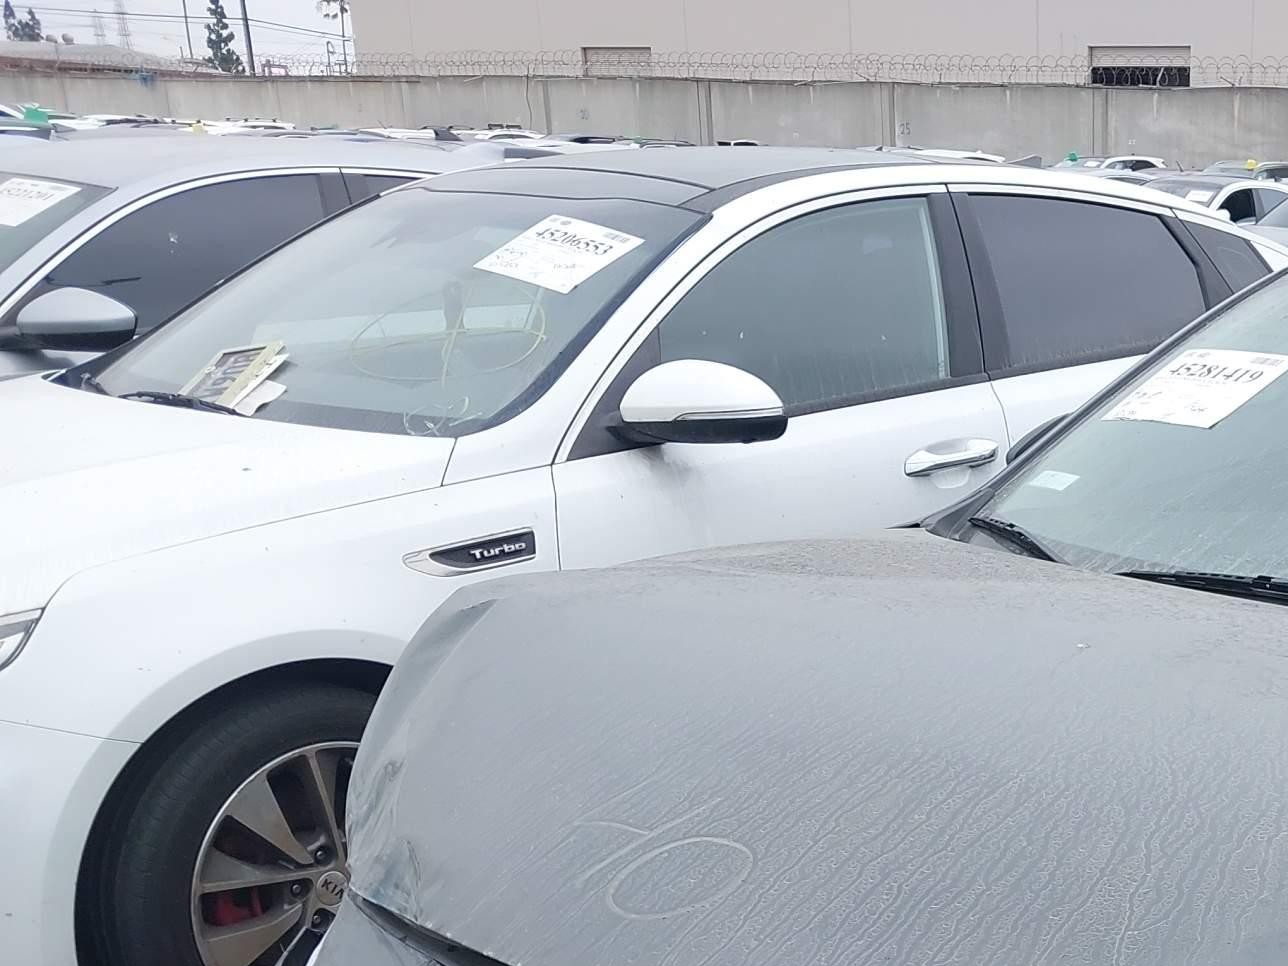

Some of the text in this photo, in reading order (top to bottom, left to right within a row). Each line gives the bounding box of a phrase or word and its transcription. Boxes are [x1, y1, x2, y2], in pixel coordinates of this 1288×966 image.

[535, 226, 614, 256] 45206553
[1169, 362, 1265, 383] 45281419
[469, 541, 527, 560] Turbo
[320, 878, 345, 900] KIA
